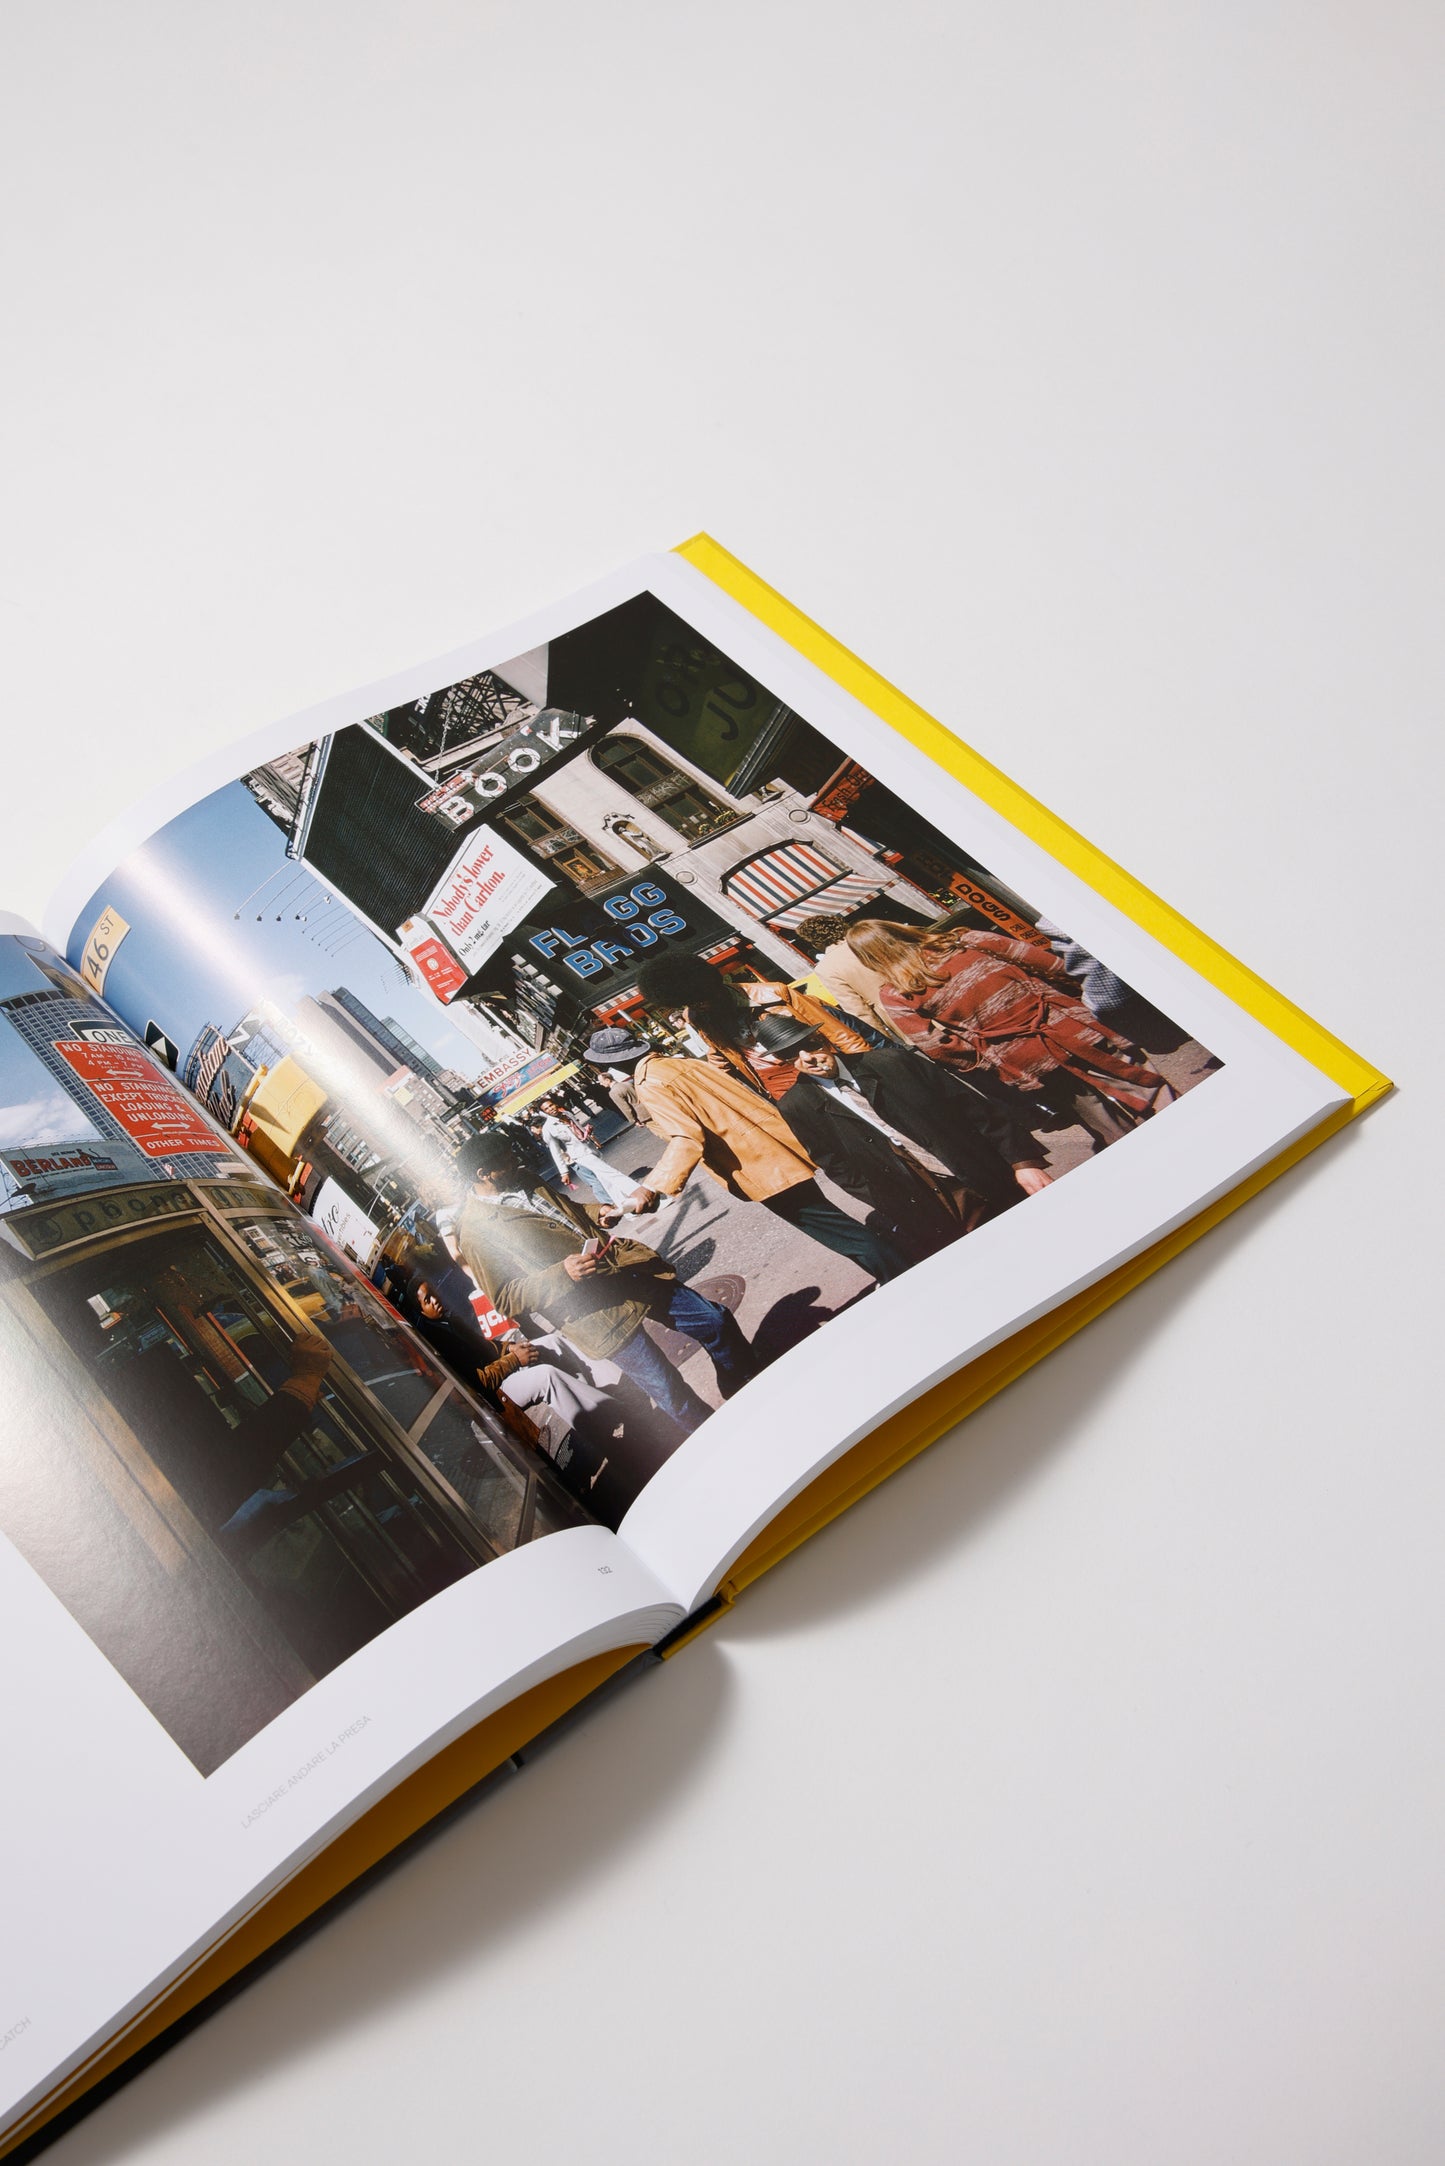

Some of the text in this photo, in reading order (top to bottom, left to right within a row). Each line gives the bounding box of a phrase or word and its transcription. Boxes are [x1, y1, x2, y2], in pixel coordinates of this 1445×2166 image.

[432, 873, 474, 919] Nobody's
[462, 845, 494, 879] lower
[955, 884, 1011, 921] DOGS
[449, 911, 474, 937] than
[481, 920, 491, 932] tar
[86, 914, 114, 979] 46 ST
[91, 1030, 134, 1044] ONE
[61, 1043, 145, 1058] NO STANDING
[477, 1048, 533, 1089] EMBASSY
[94, 1082, 178, 1095] NO STANDING
[101, 1092, 144, 1103] EXCEPT
[120, 1102, 186, 1112] LOADING &
[127, 1112, 196, 1122] UNLOADING
[146, 1138, 220, 1149] OTHER TIMES
[241, 1715, 372, 1829] LASCIARE ANDARE LA PRESA
